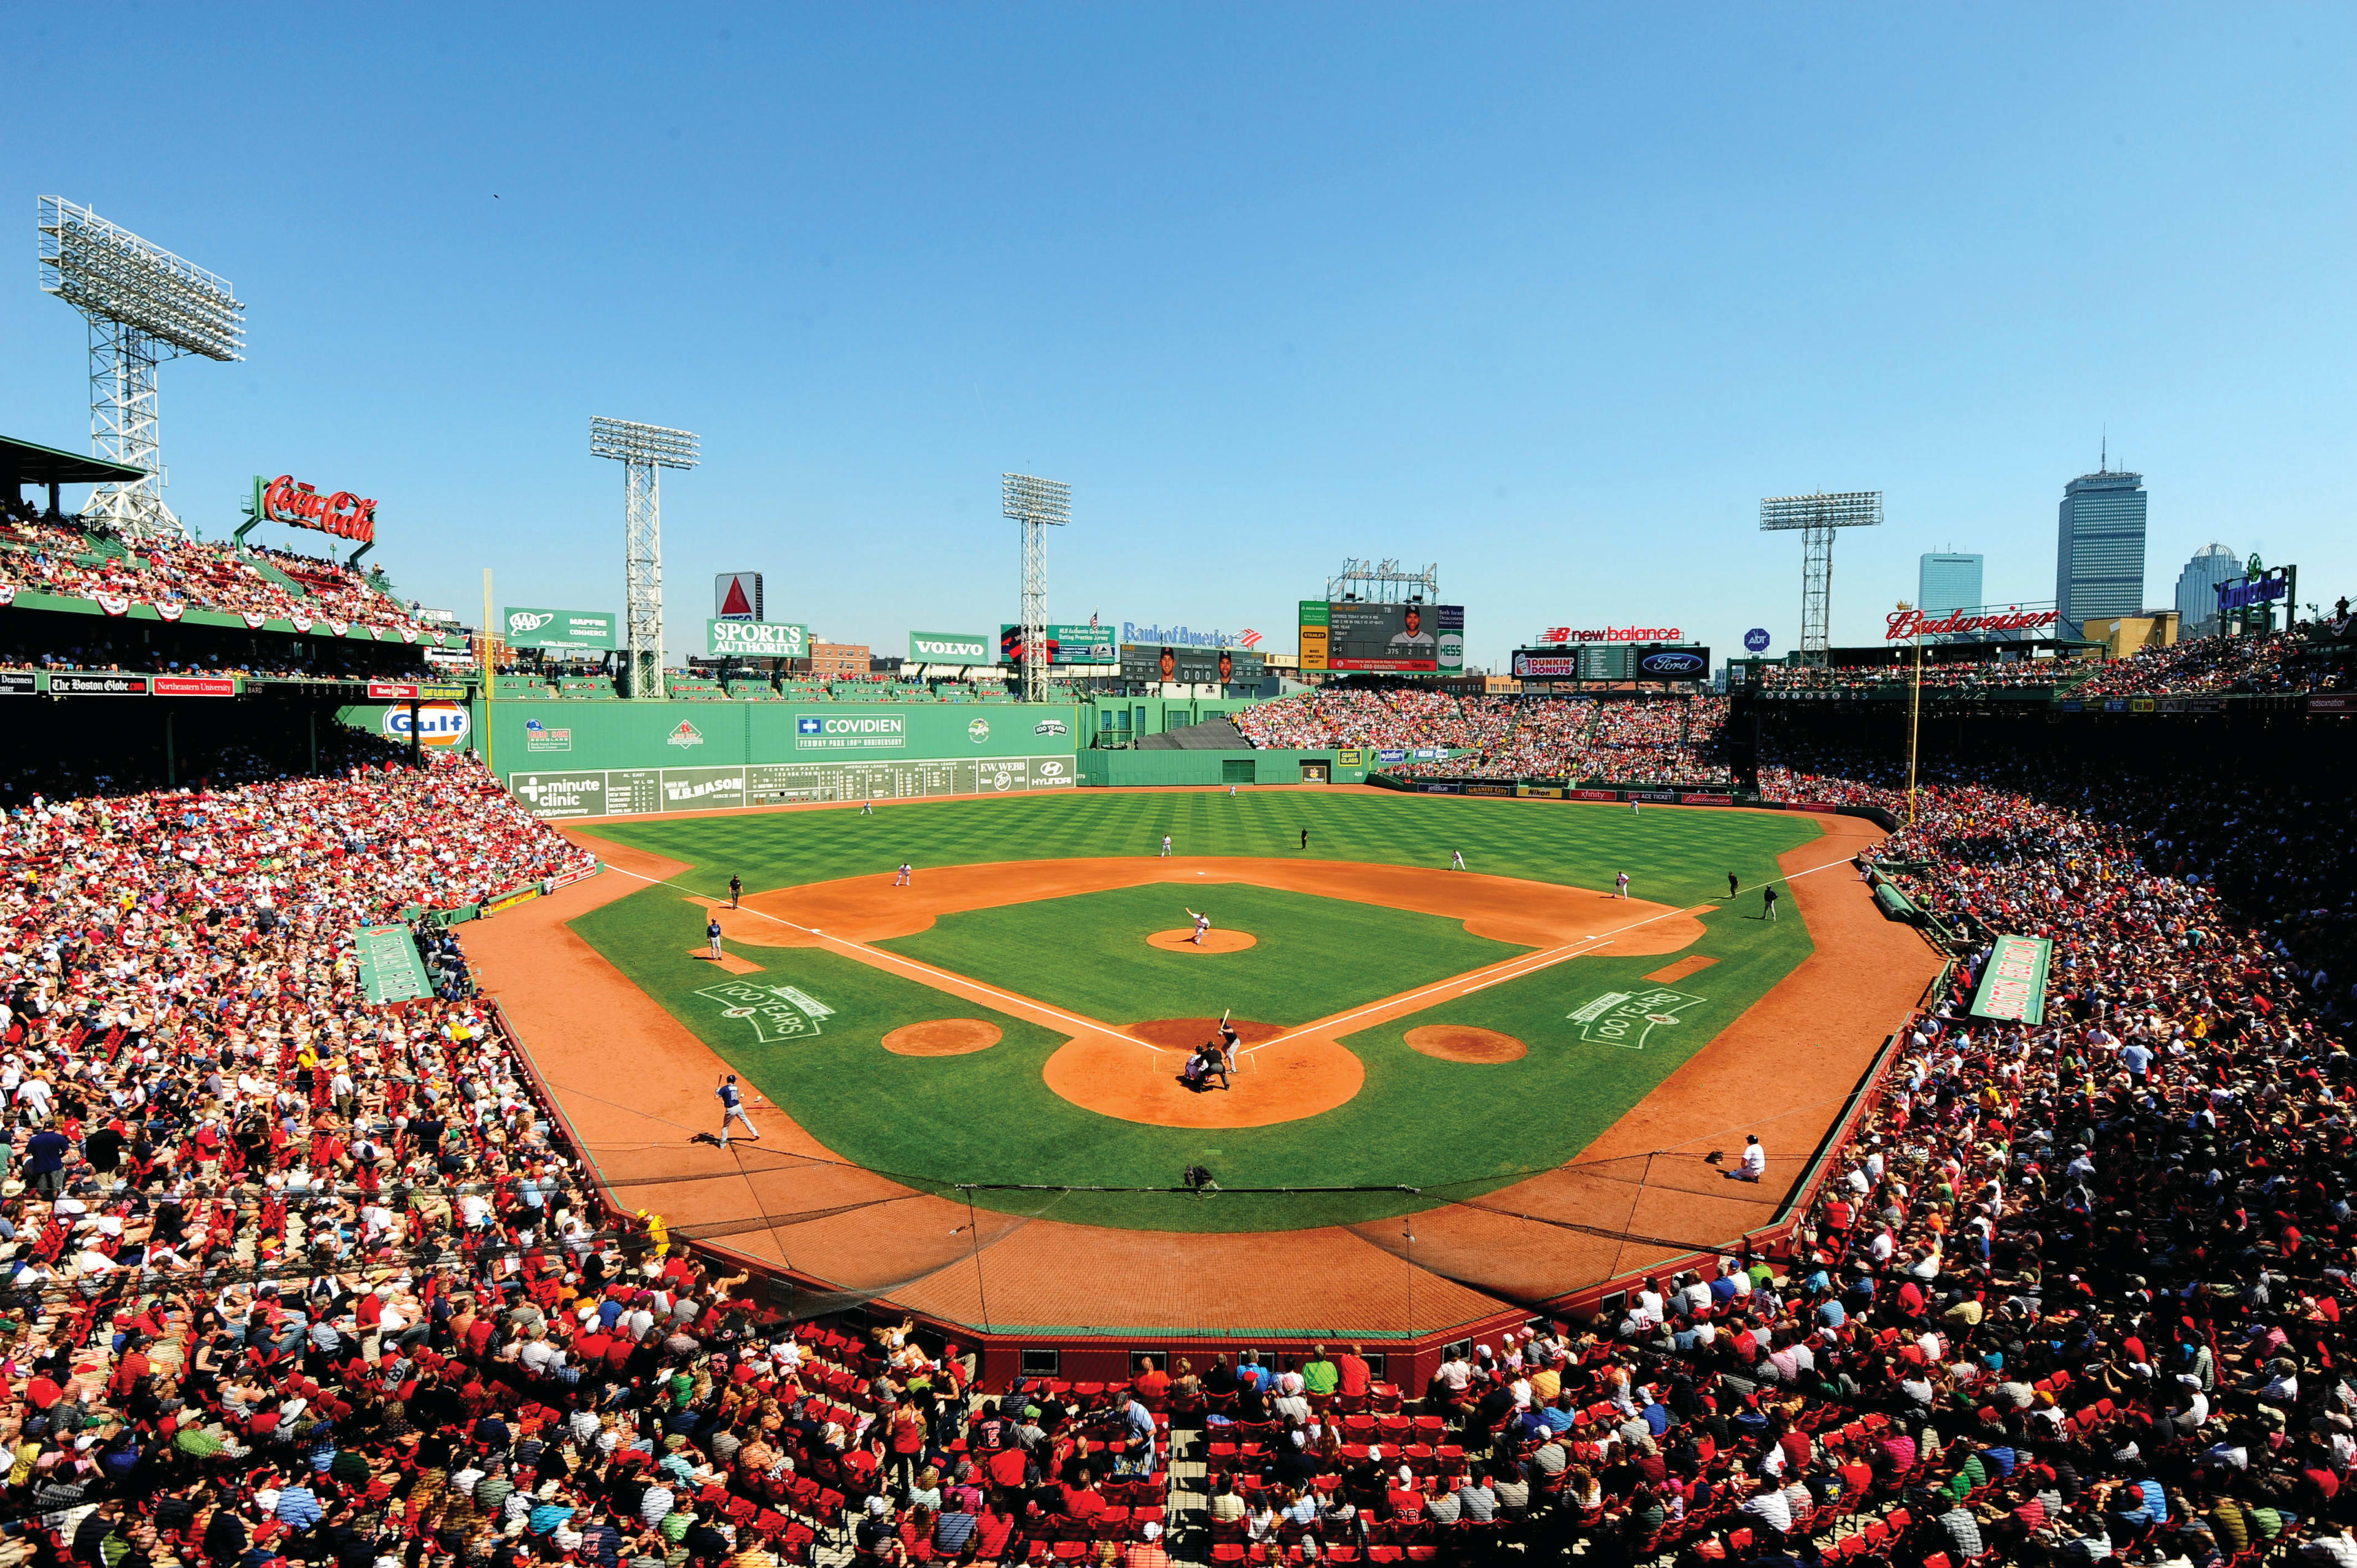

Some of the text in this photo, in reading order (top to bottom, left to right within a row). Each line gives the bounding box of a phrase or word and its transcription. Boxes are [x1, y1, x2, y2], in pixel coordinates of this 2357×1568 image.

[264, 475, 377, 543] Coca-Cola
[1329, 557, 1439, 597] John Hancock
[513, 615, 536, 630] AAA
[1886, 606, 2061, 640] Budweiser
[714, 622, 801, 643] SPORTS
[1124, 622, 1234, 647] Bank of America
[1572, 625, 1680, 641] new balance
[714, 641, 801, 654] AUTHORITY
[915, 641, 984, 655] VOLVO
[1440, 644, 1461, 656] HESS
[1654, 655, 1693, 671] Ford
[1184, 670, 1210, 681] 0 0 0
[52, 679, 145, 692] The Boston Globe.com
[158, 682, 231, 693] Northeastern University
[390, 714, 462, 732] Gulf
[826, 719, 901, 733] COVIDIEN
[999, 762, 1025, 771] WEBB
[548, 778, 600, 792] minute
[1032, 777, 1071, 786] HYUNDAI
[540, 792, 580, 807] clinic
[1581, 790, 1605, 799] xfinity
[1685, 794, 1730, 803] Budweiser
[532, 808, 589, 817] CVS/pharmacy
[2002, 946, 2039, 964] SOX
[1995, 961, 2034, 981] RED
[1611, 993, 1681, 1019] YEARS
[1983, 978, 2031, 1020] BOSTON
[718, 986, 805, 1034] 100 YEARS
[1596, 1019, 1630, 1040] 100
